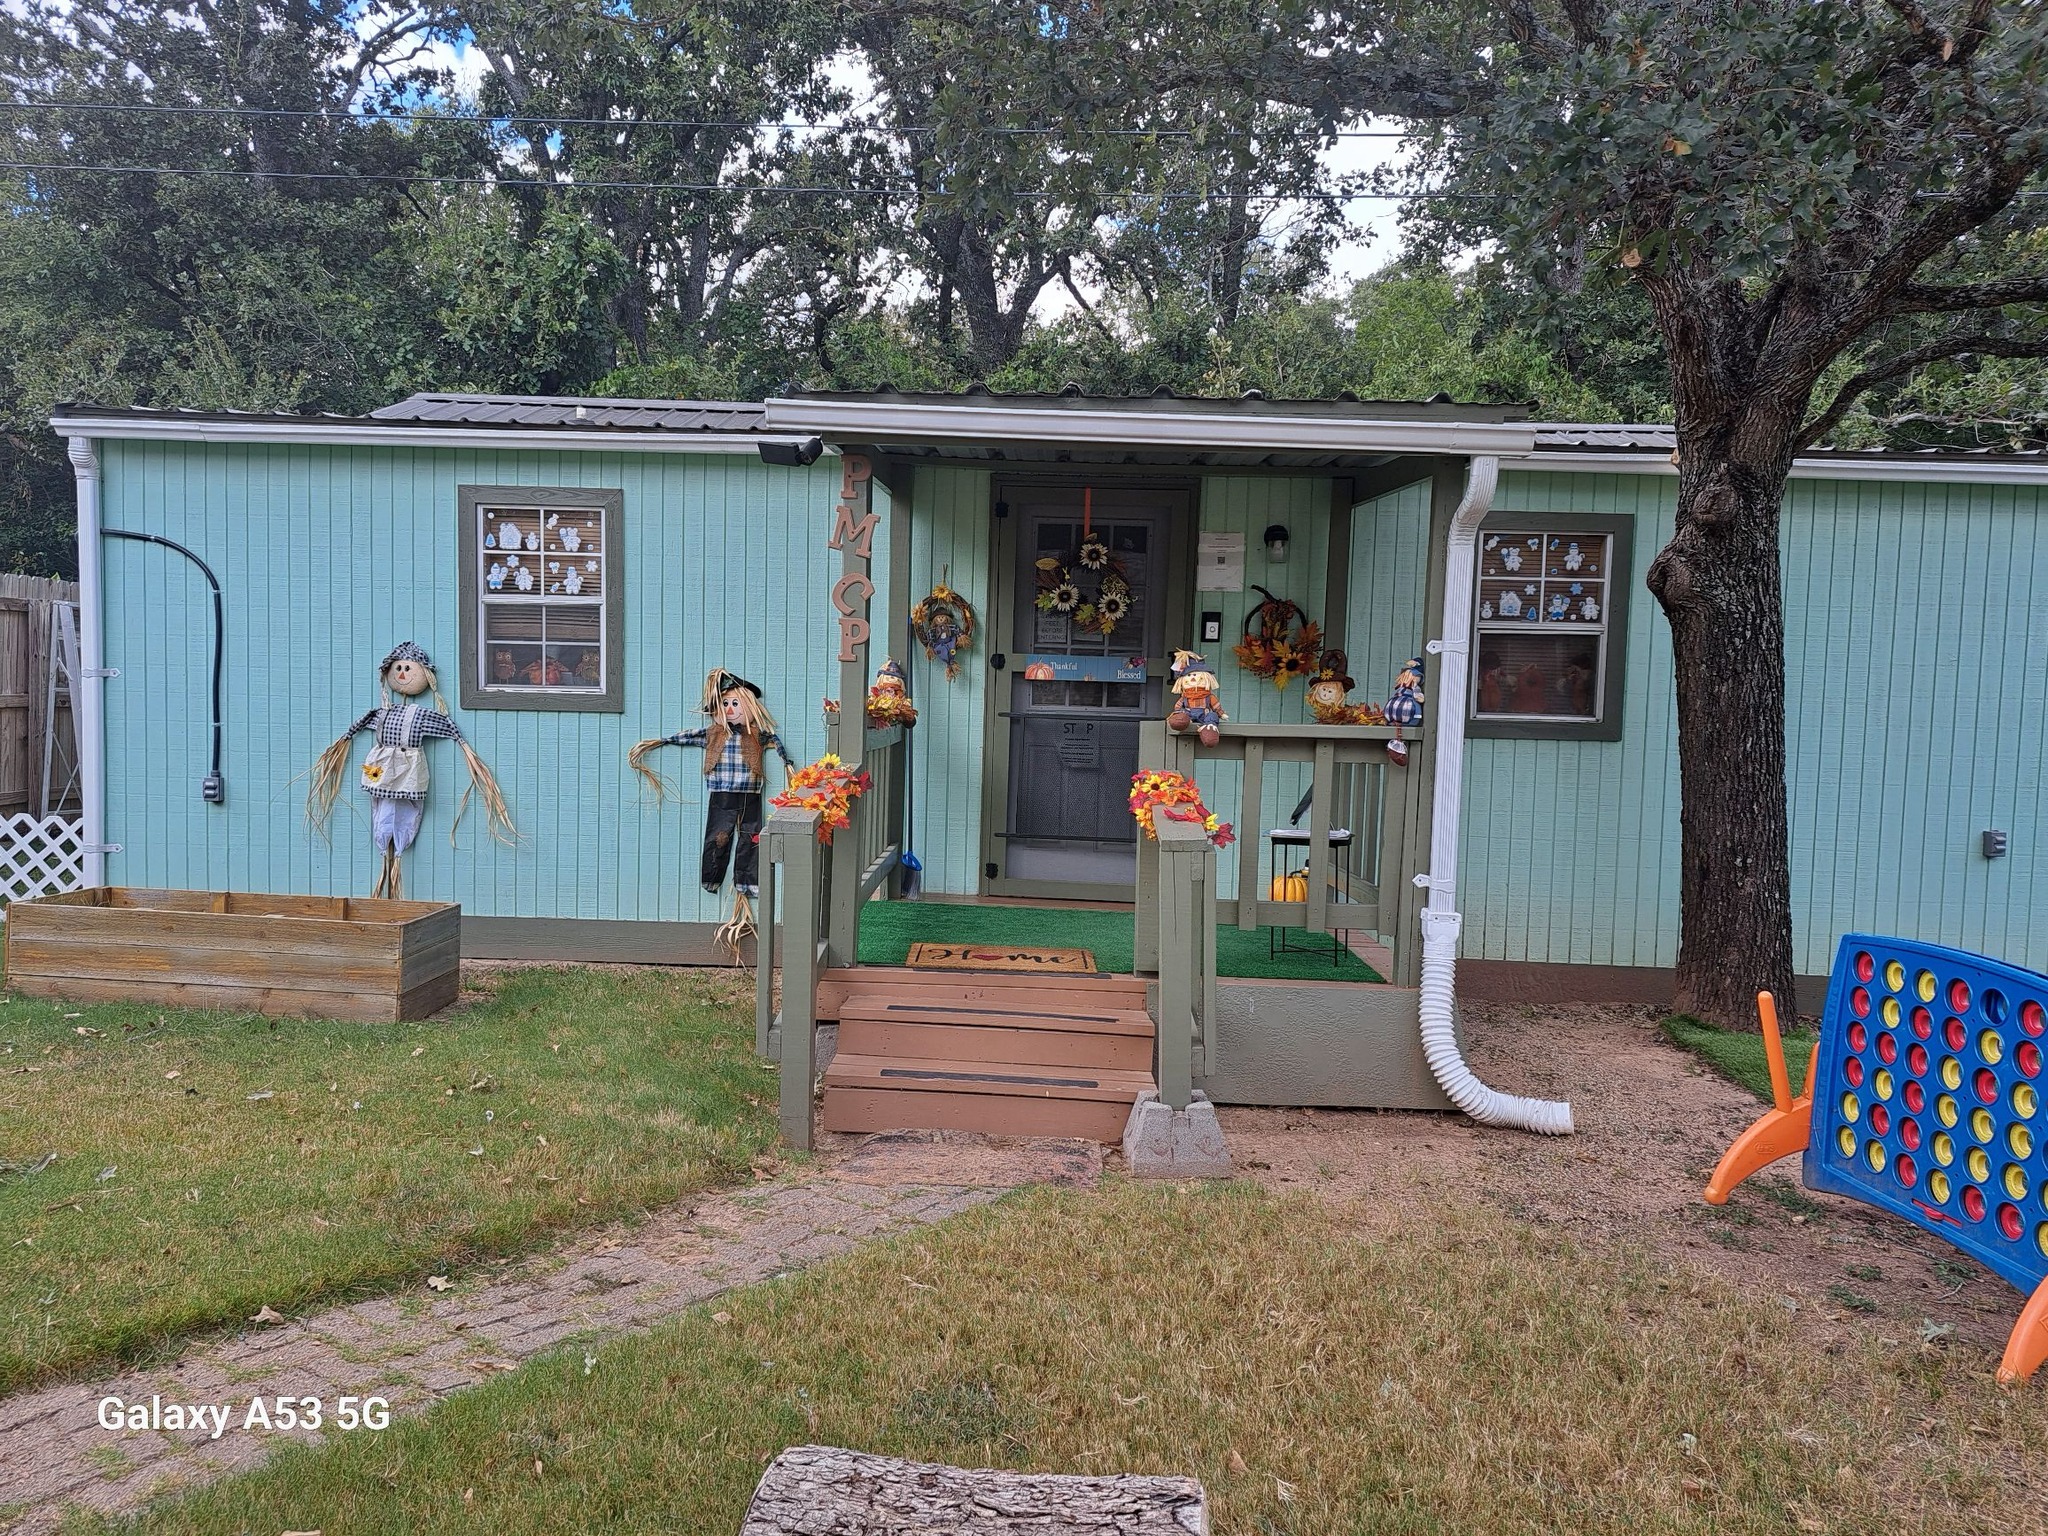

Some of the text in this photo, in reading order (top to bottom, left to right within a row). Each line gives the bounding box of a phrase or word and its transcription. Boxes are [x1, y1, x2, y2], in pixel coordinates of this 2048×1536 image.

[1050, 661, 1078, 670] Thankful
[1117, 669, 1141, 680] Blessed
[1063, 722, 1094, 734] STP
